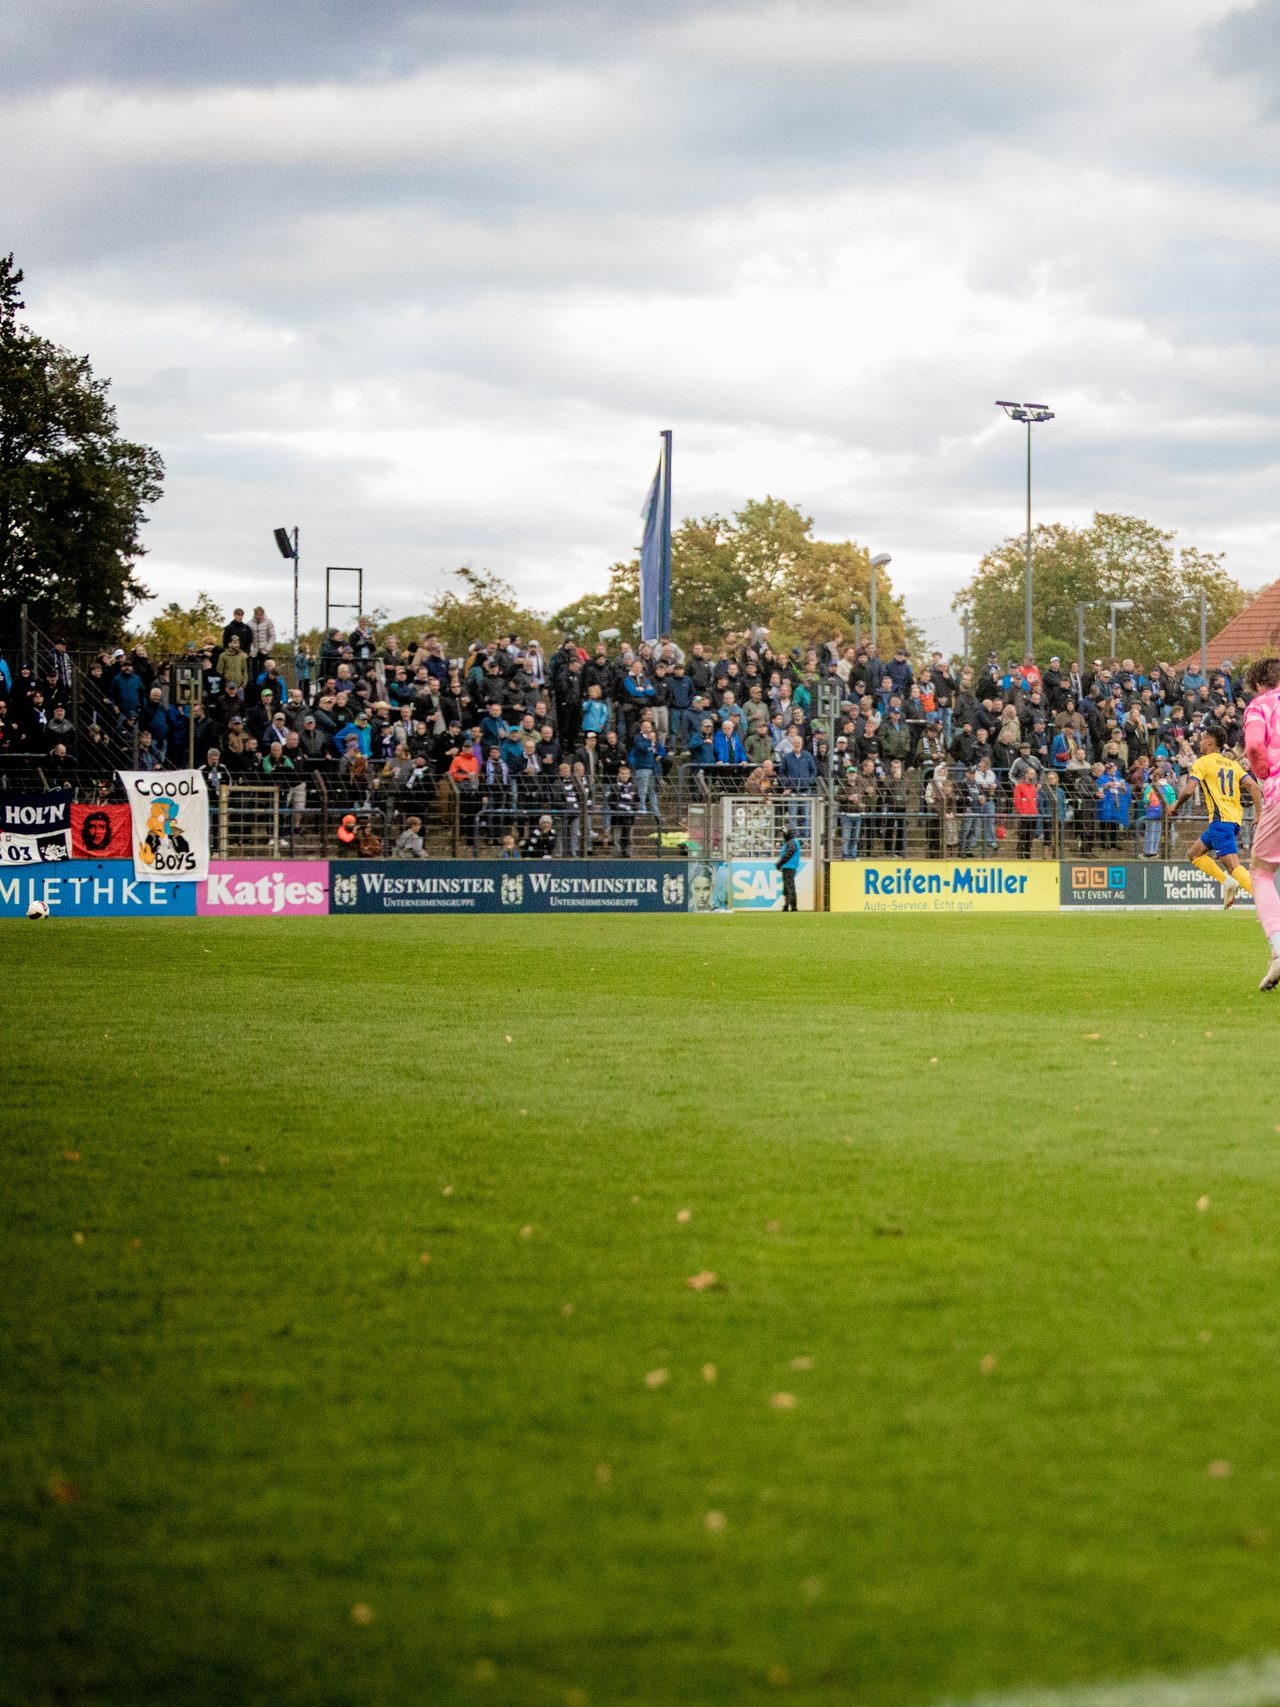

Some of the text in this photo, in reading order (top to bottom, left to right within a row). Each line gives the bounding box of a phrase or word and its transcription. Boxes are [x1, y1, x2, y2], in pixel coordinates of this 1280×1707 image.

[134, 776, 199, 797] COOOL
[1217, 768, 1234, 797] 11
[5, 803, 66, 825] HOL'N
[8, 845, 32, 861] 03
[155, 852, 197, 870] BOYS
[0, 878, 168, 904] MIETHKE
[361, 873, 495, 894] WESTMINSTER
[528, 873, 658, 893] WESTMINSTER
[732, 869, 783, 900] SAP
[864, 867, 1028, 895] Reifen-Müller
[1163, 883, 1216, 899] Technik
[206, 872, 325, 913] Katjes
[1072, 890, 1126, 899] TLT EVENT AG
[863, 900, 930, 911] Auto-Service.
[933, 899, 955, 910] Echt
